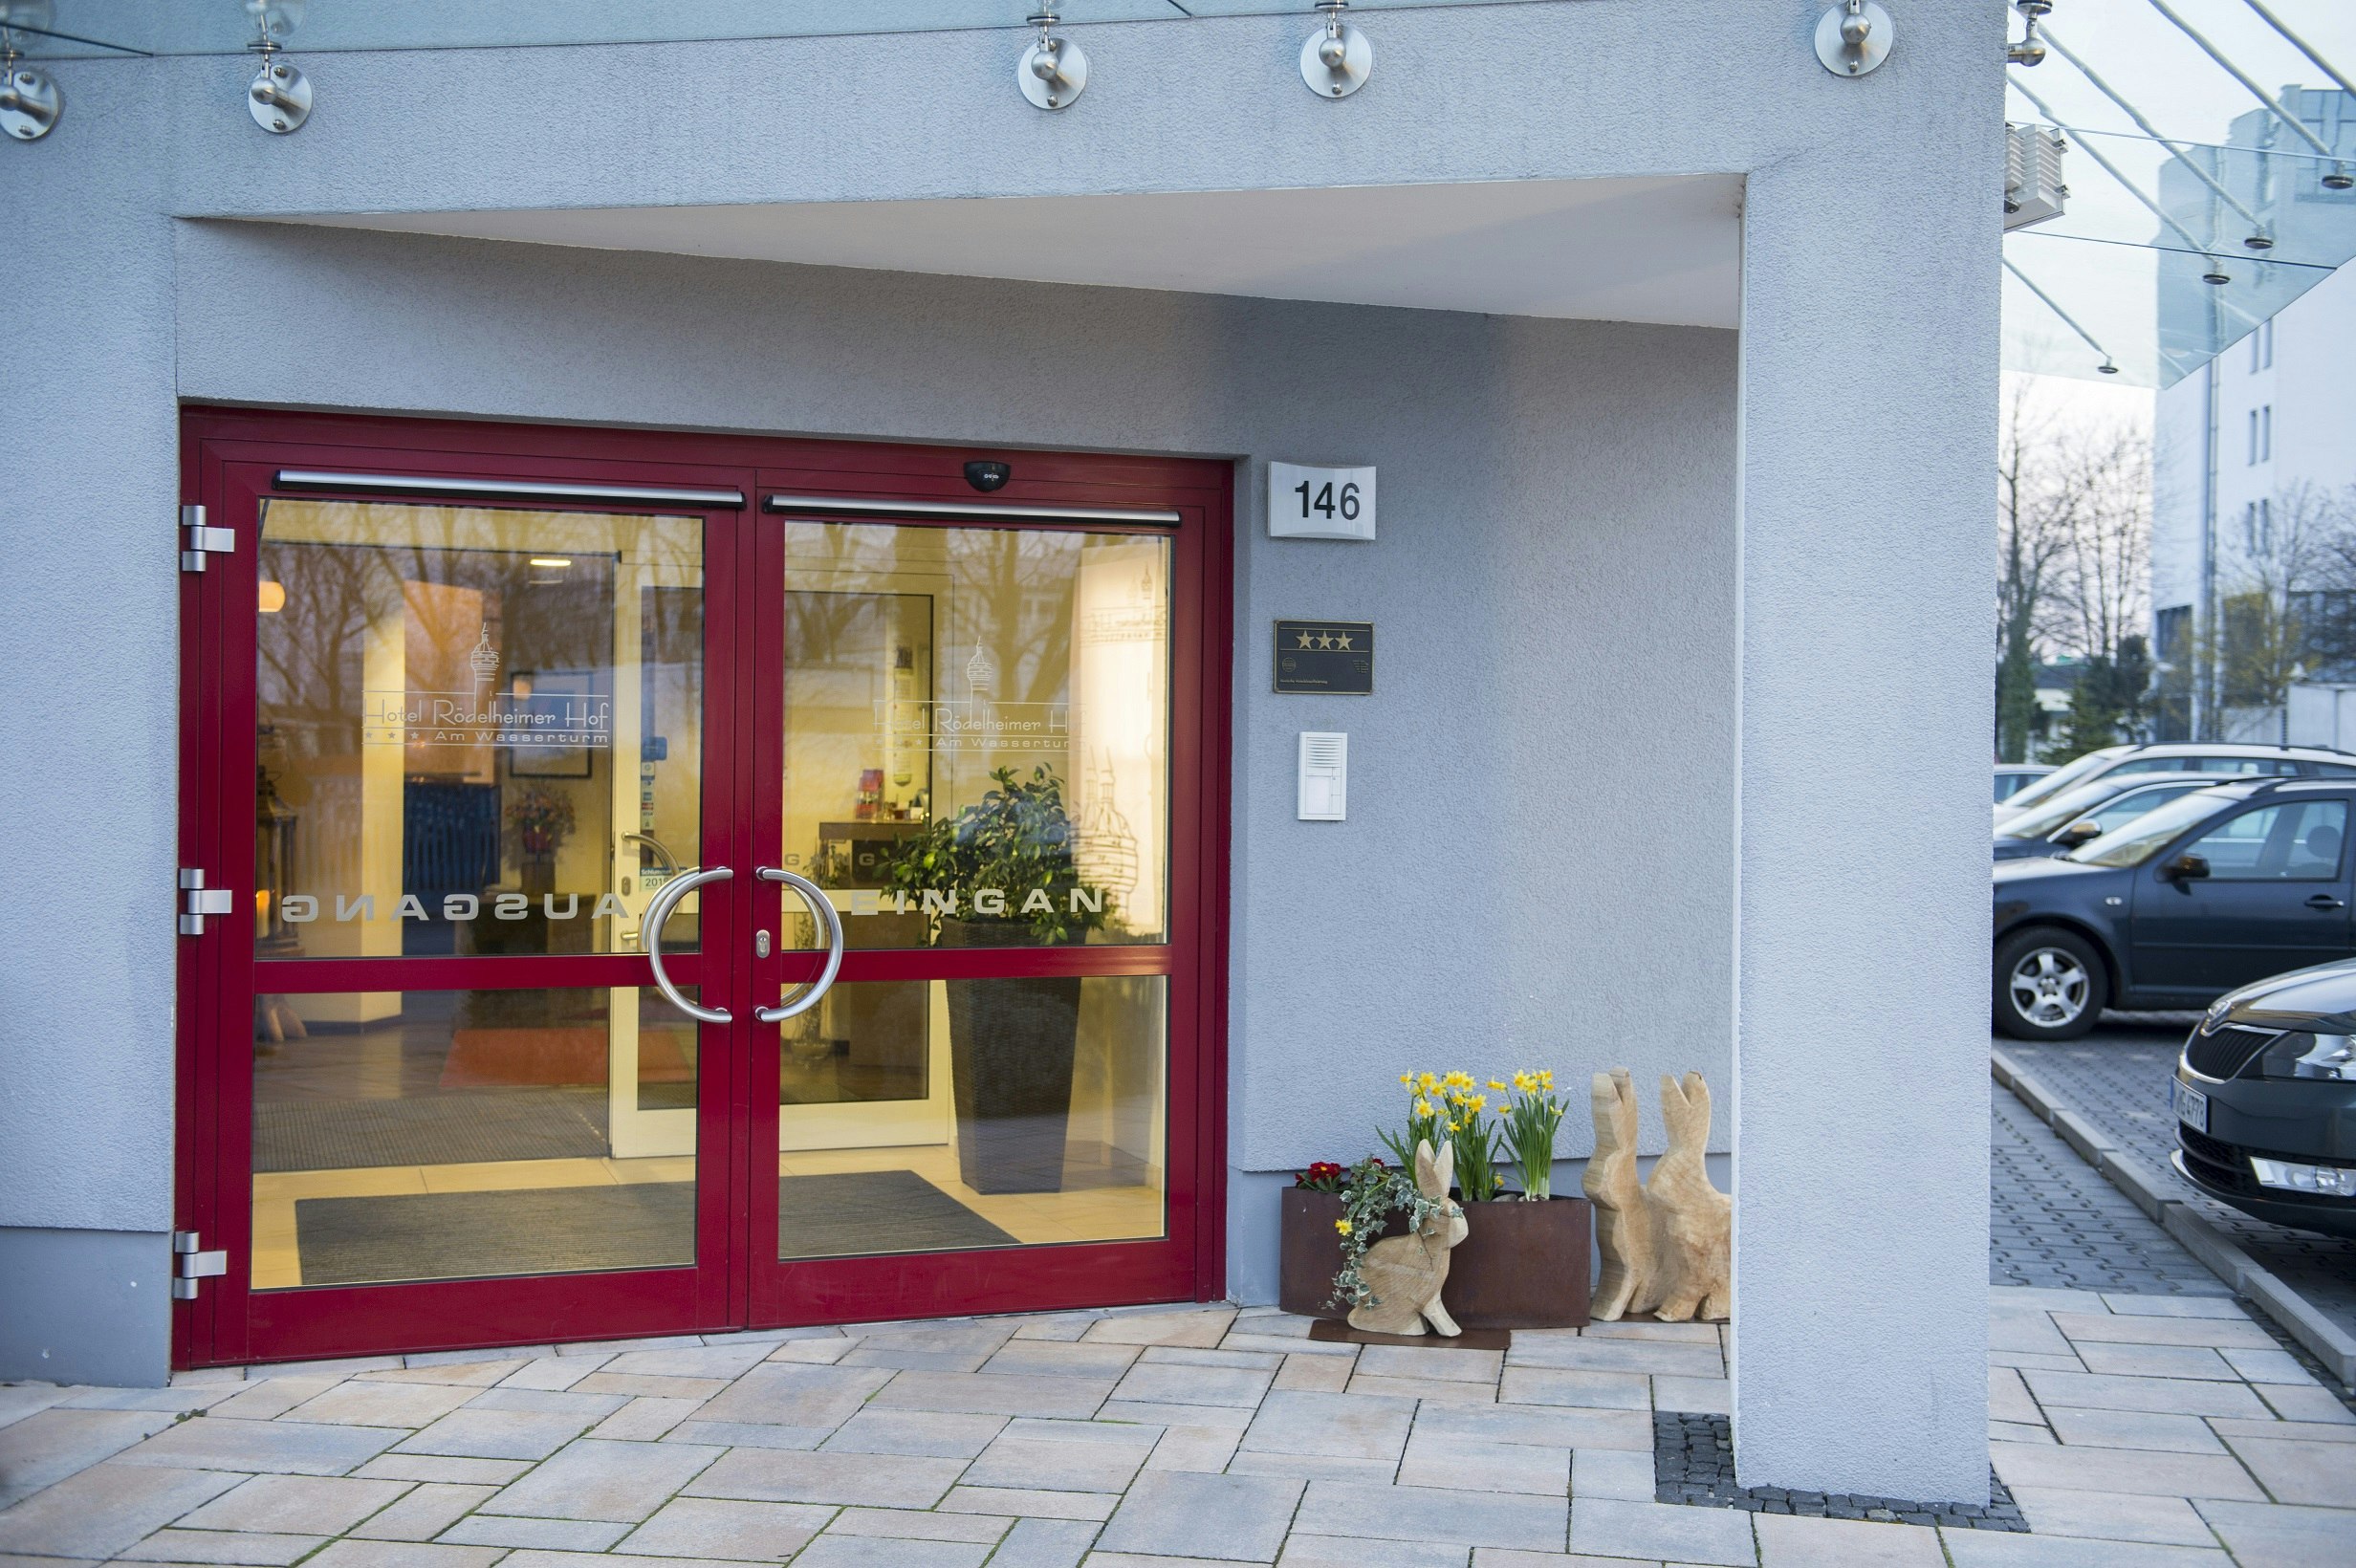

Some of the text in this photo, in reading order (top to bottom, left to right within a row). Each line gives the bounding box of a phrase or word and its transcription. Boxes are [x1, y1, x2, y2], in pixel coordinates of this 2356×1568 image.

[1295, 480, 1360, 520] 146
[361, 699, 609, 730] Hotel Rödelheimer Hof
[934, 708, 1041, 732] Rödelheimer
[434, 731, 609, 743] Am Wasserturm
[935, 737, 1086, 749] Am Wassertur
